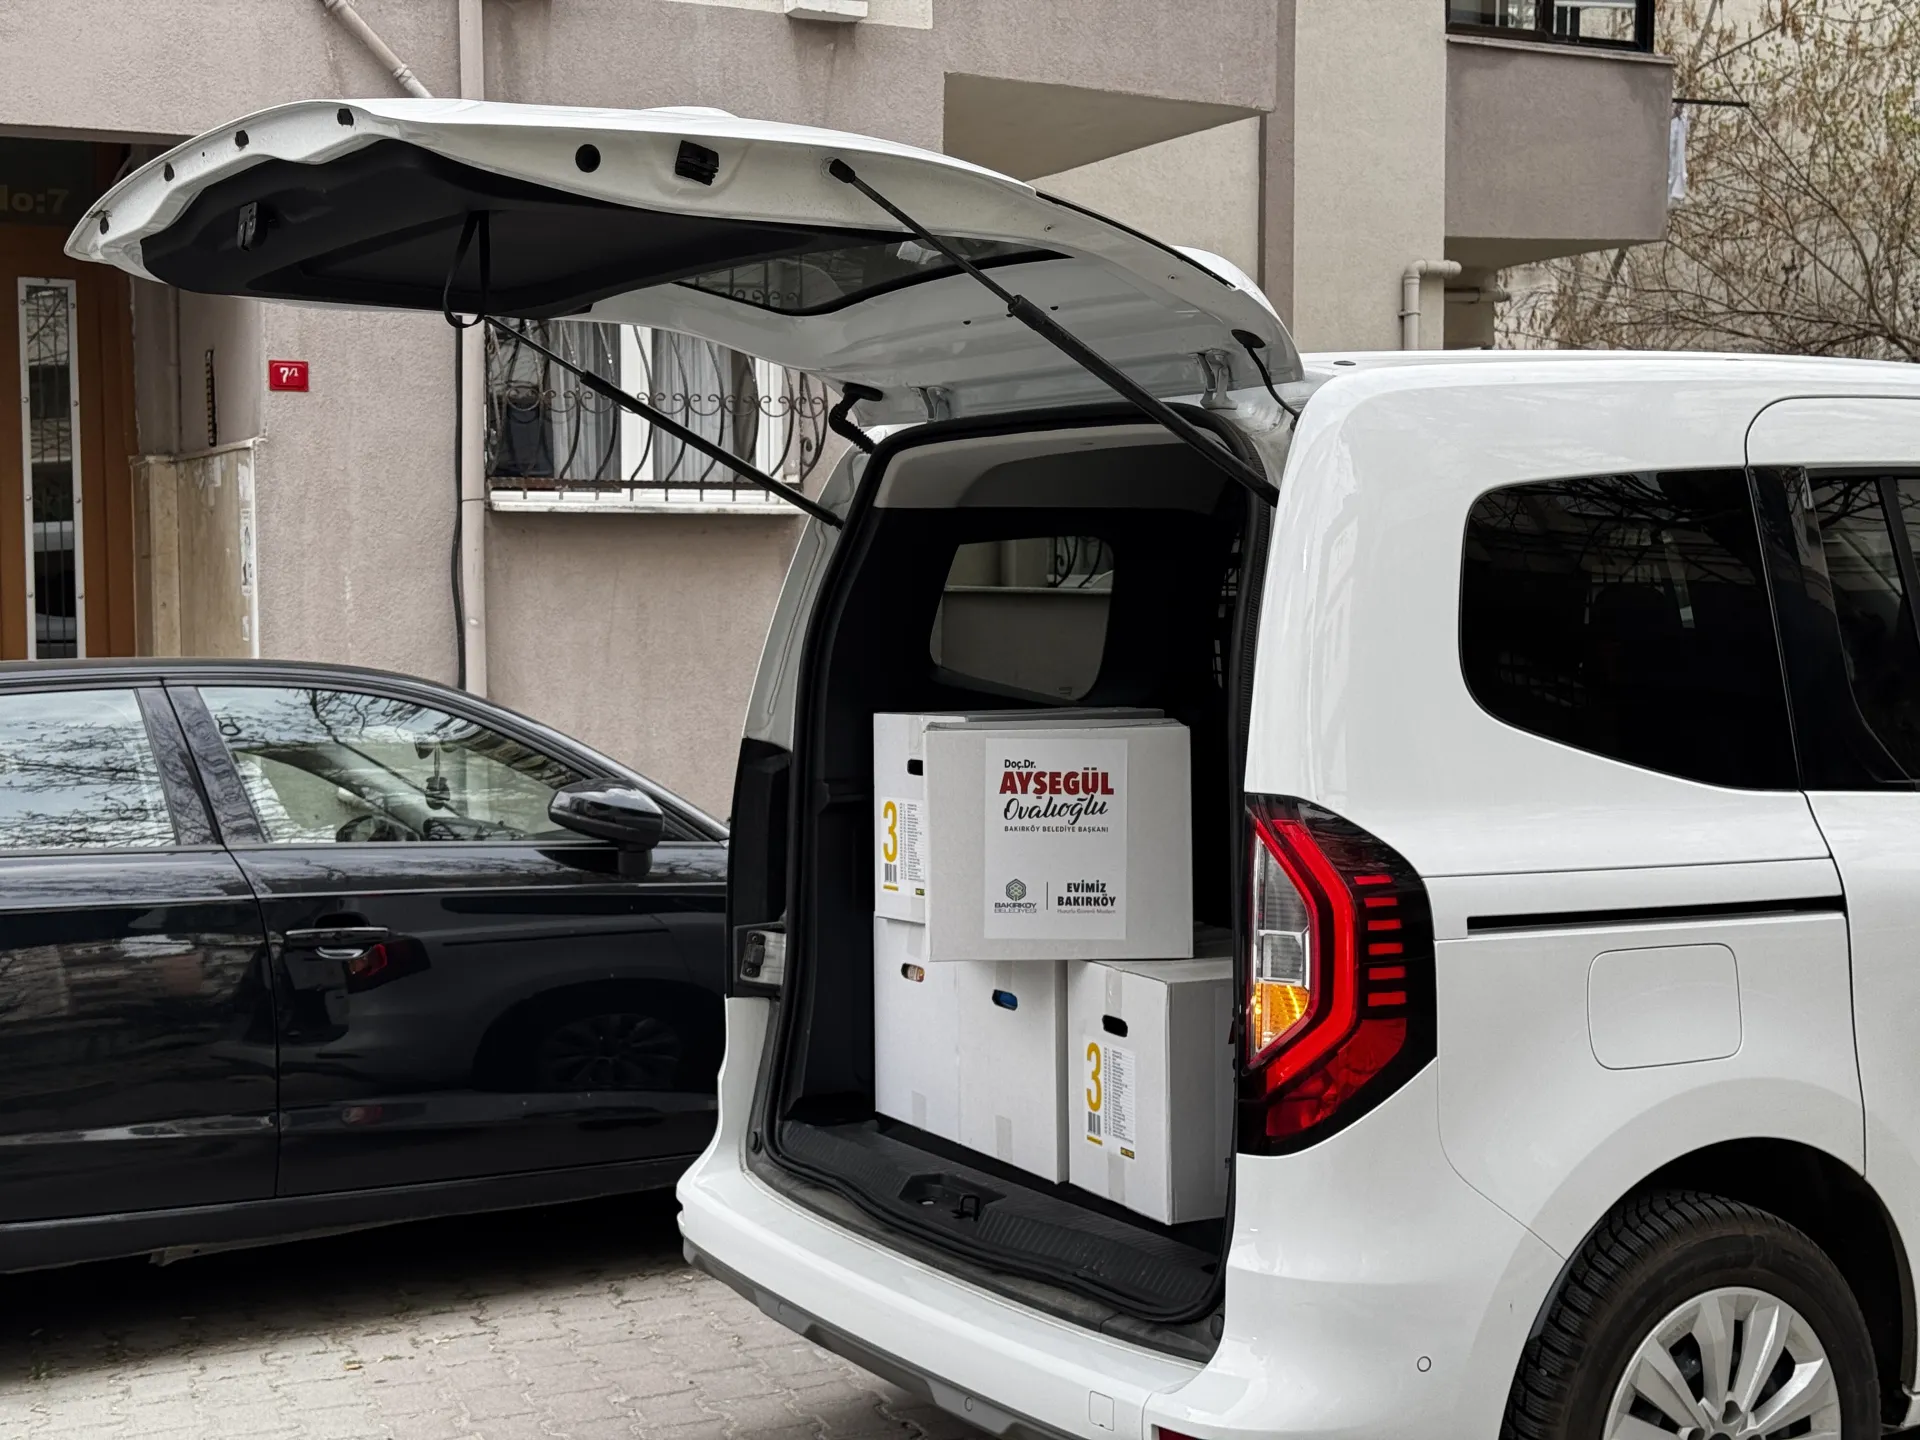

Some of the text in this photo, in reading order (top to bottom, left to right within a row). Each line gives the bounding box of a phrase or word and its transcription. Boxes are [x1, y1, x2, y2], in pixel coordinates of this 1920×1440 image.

[999, 767, 1115, 799] AYŞEGÜL
[1003, 794, 1109, 825] Ovalıoğlu
[883, 801, 898, 863] 3
[1004, 825, 1109, 834] BAKIRKÖY BELEDİYE BAŞKANI
[1057, 894, 1117, 907] BAKIRKÖY
[1067, 880, 1107, 893] EVİMİZ
[1086, 1042, 1102, 1112] 3
